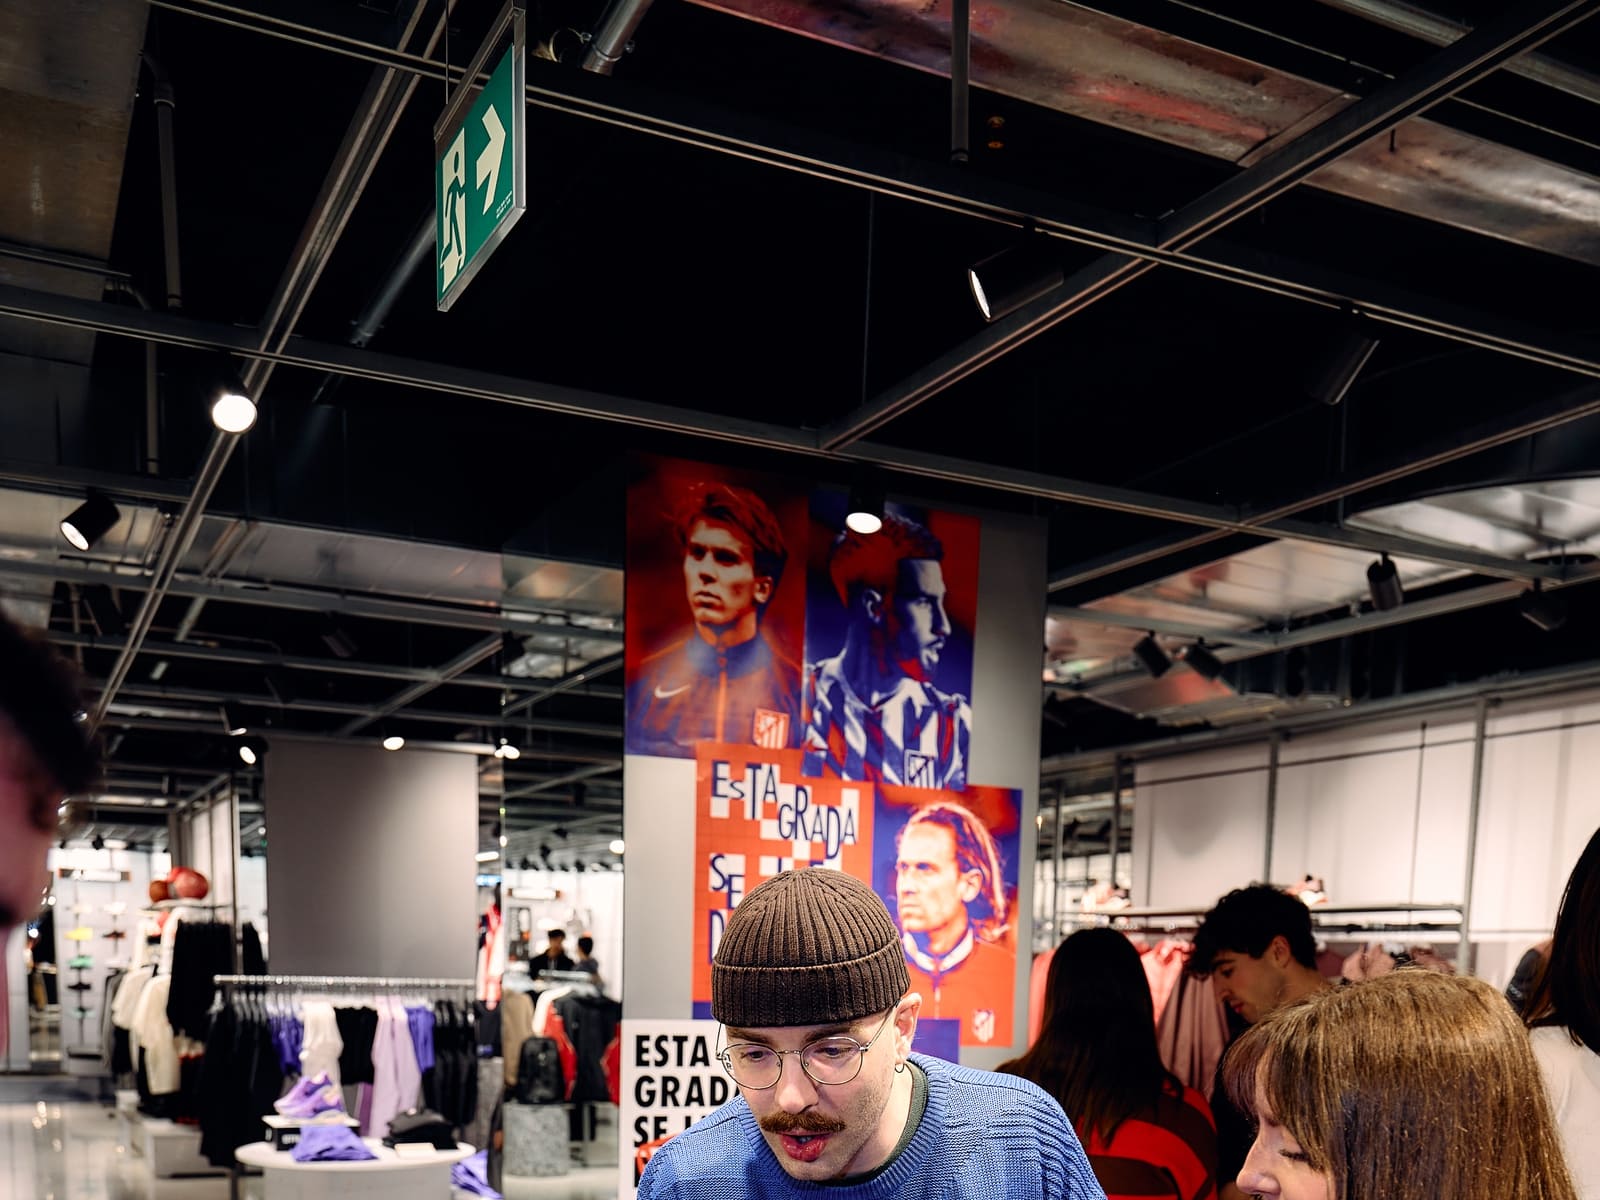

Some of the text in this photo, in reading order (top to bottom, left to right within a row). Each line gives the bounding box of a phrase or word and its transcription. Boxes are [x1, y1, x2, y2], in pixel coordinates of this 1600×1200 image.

[779, 785, 857, 860] GRADA
[710, 854, 745, 910] SE
[635, 1034, 710, 1067] ESTA
[634, 1075, 739, 1108] GRAD
